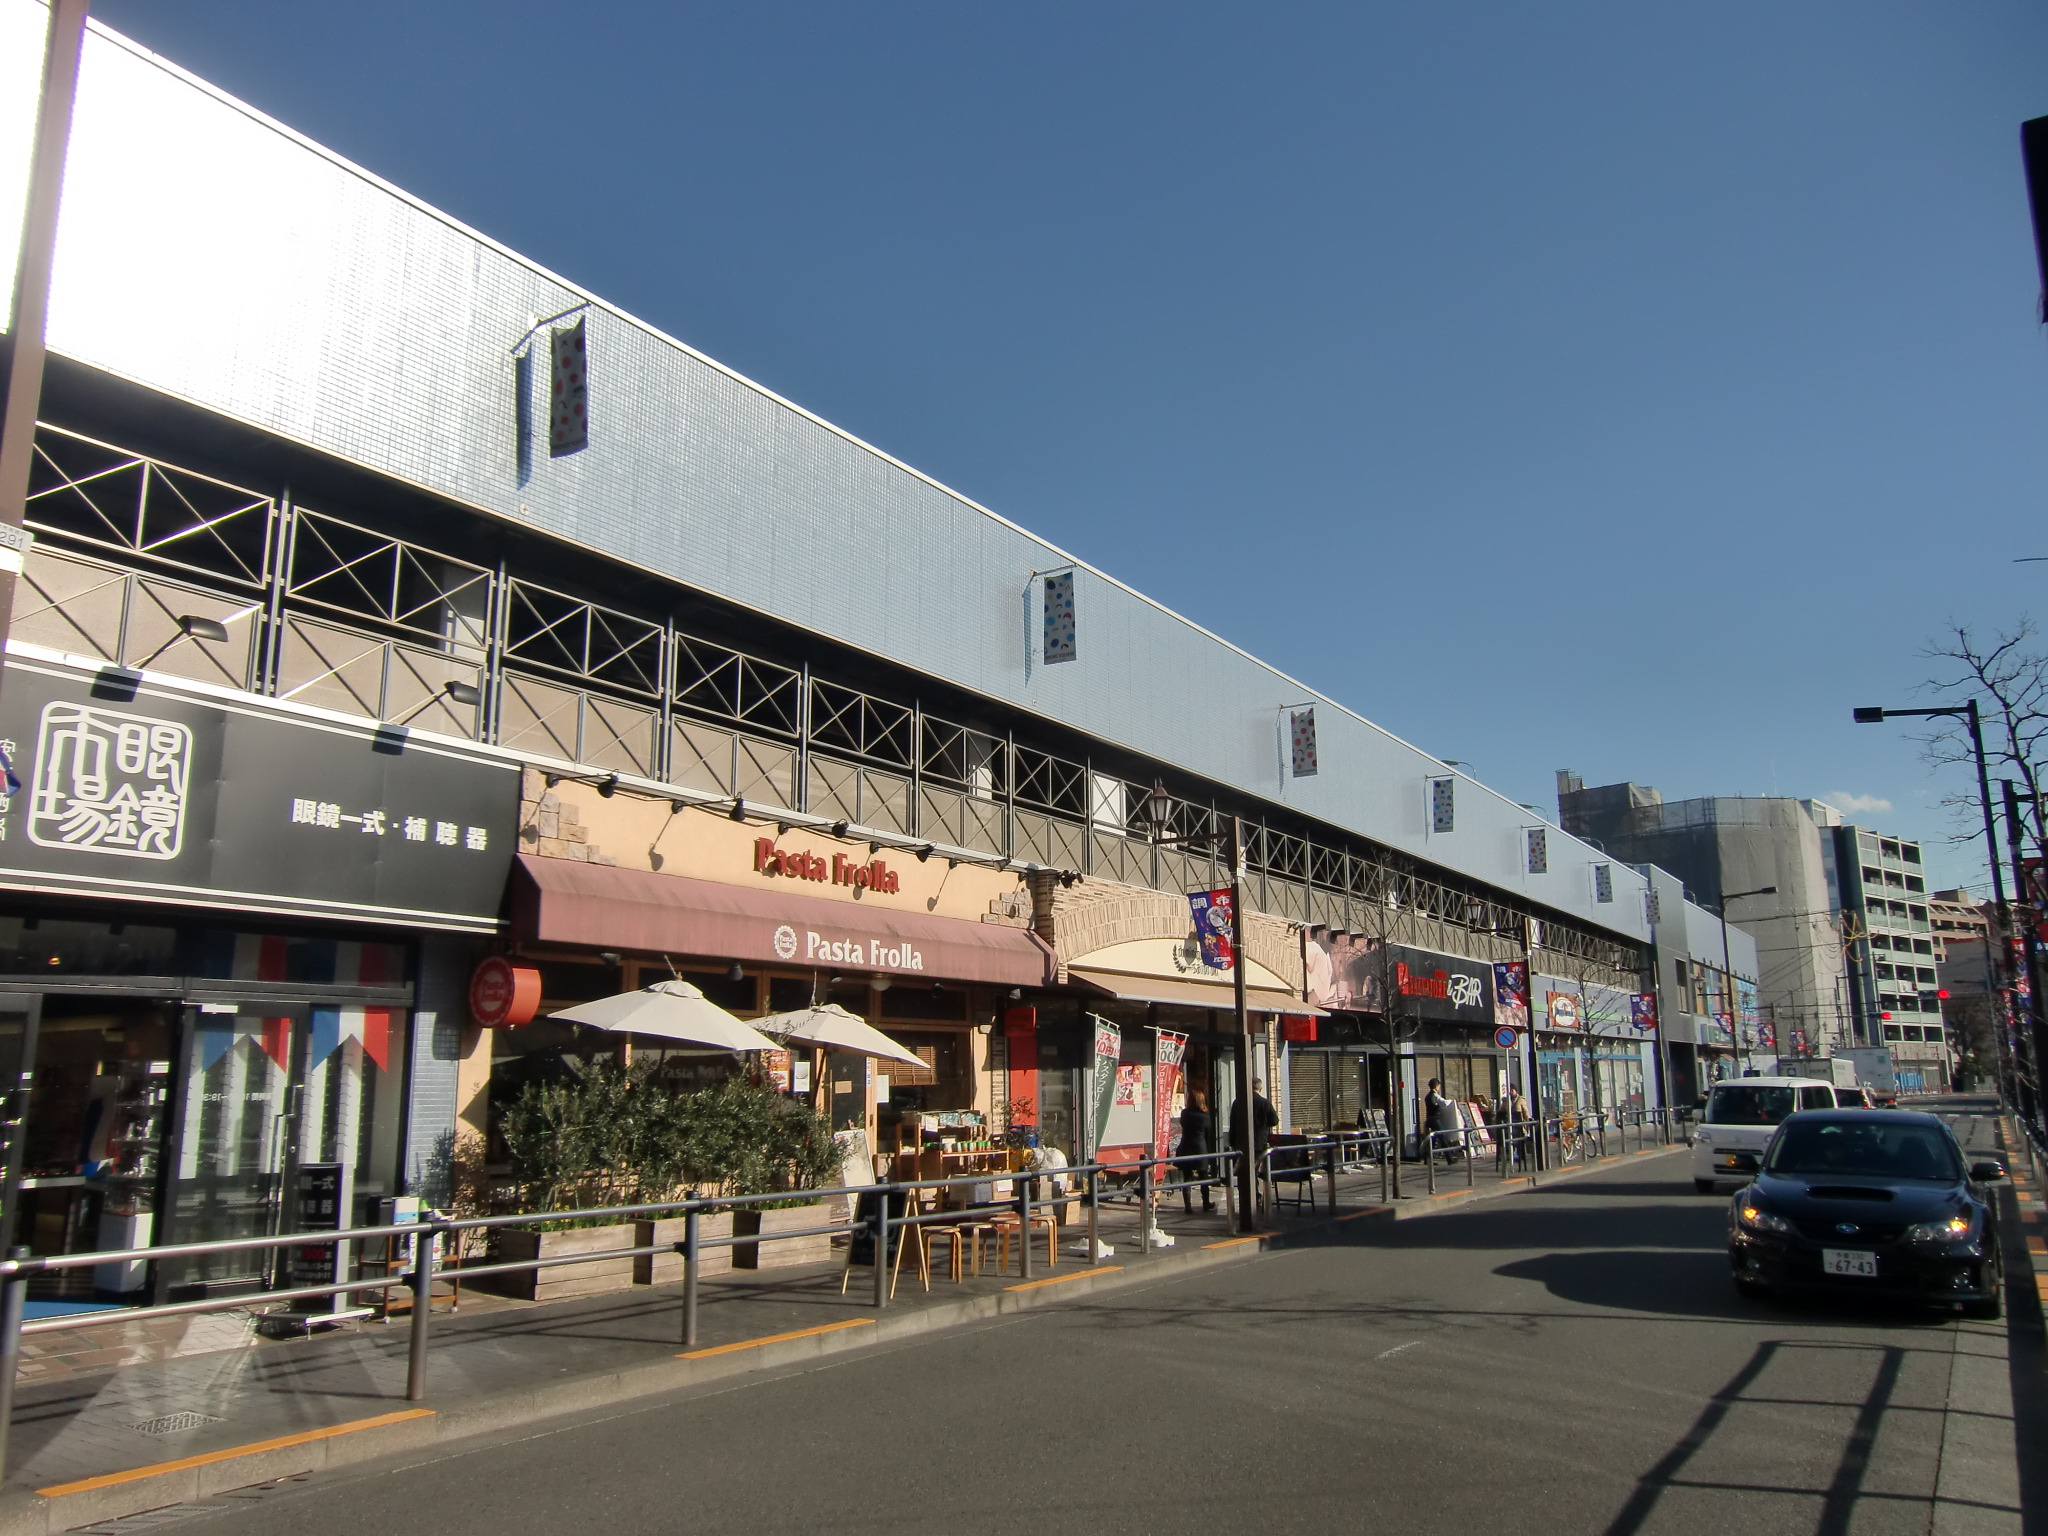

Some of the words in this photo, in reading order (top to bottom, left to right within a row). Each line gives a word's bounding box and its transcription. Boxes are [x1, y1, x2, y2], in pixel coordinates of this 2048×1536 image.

[756, 836, 829, 881] Pasta
[833, 852, 900, 893] Frolla
[806, 931, 865, 965] Pasta
[869, 939, 923, 971] Frolla
[1835, 1260, 1873, 1275] 67-43
